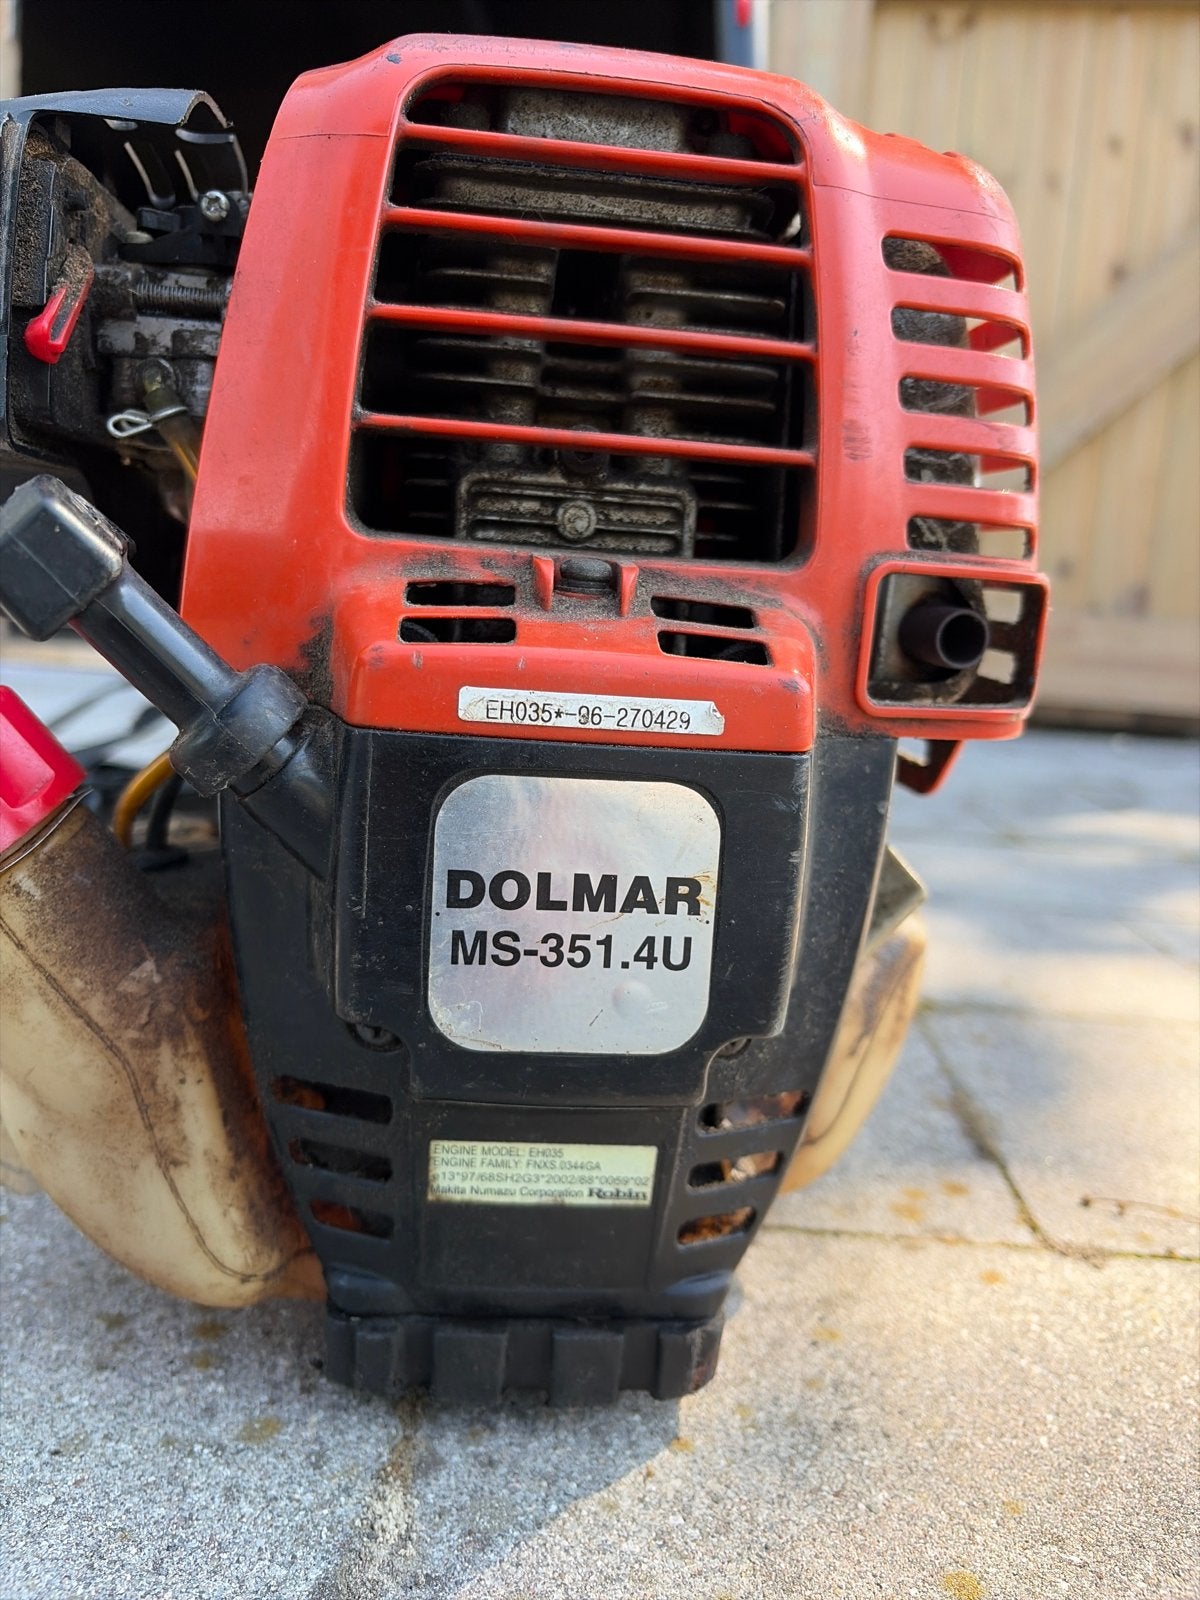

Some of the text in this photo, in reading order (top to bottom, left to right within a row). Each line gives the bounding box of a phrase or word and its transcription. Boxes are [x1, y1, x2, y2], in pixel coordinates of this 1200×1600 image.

[446, 869, 702, 916] DOLMAR
[450, 929, 693, 971] MS-351.4U
[434, 1144, 477, 1156] ENGINE
[529, 1147, 564, 1159] EH035
[433, 1157, 477, 1168] ENGINE
[431, 1184, 648, 1201] Makita Numazu Corporation Robin
